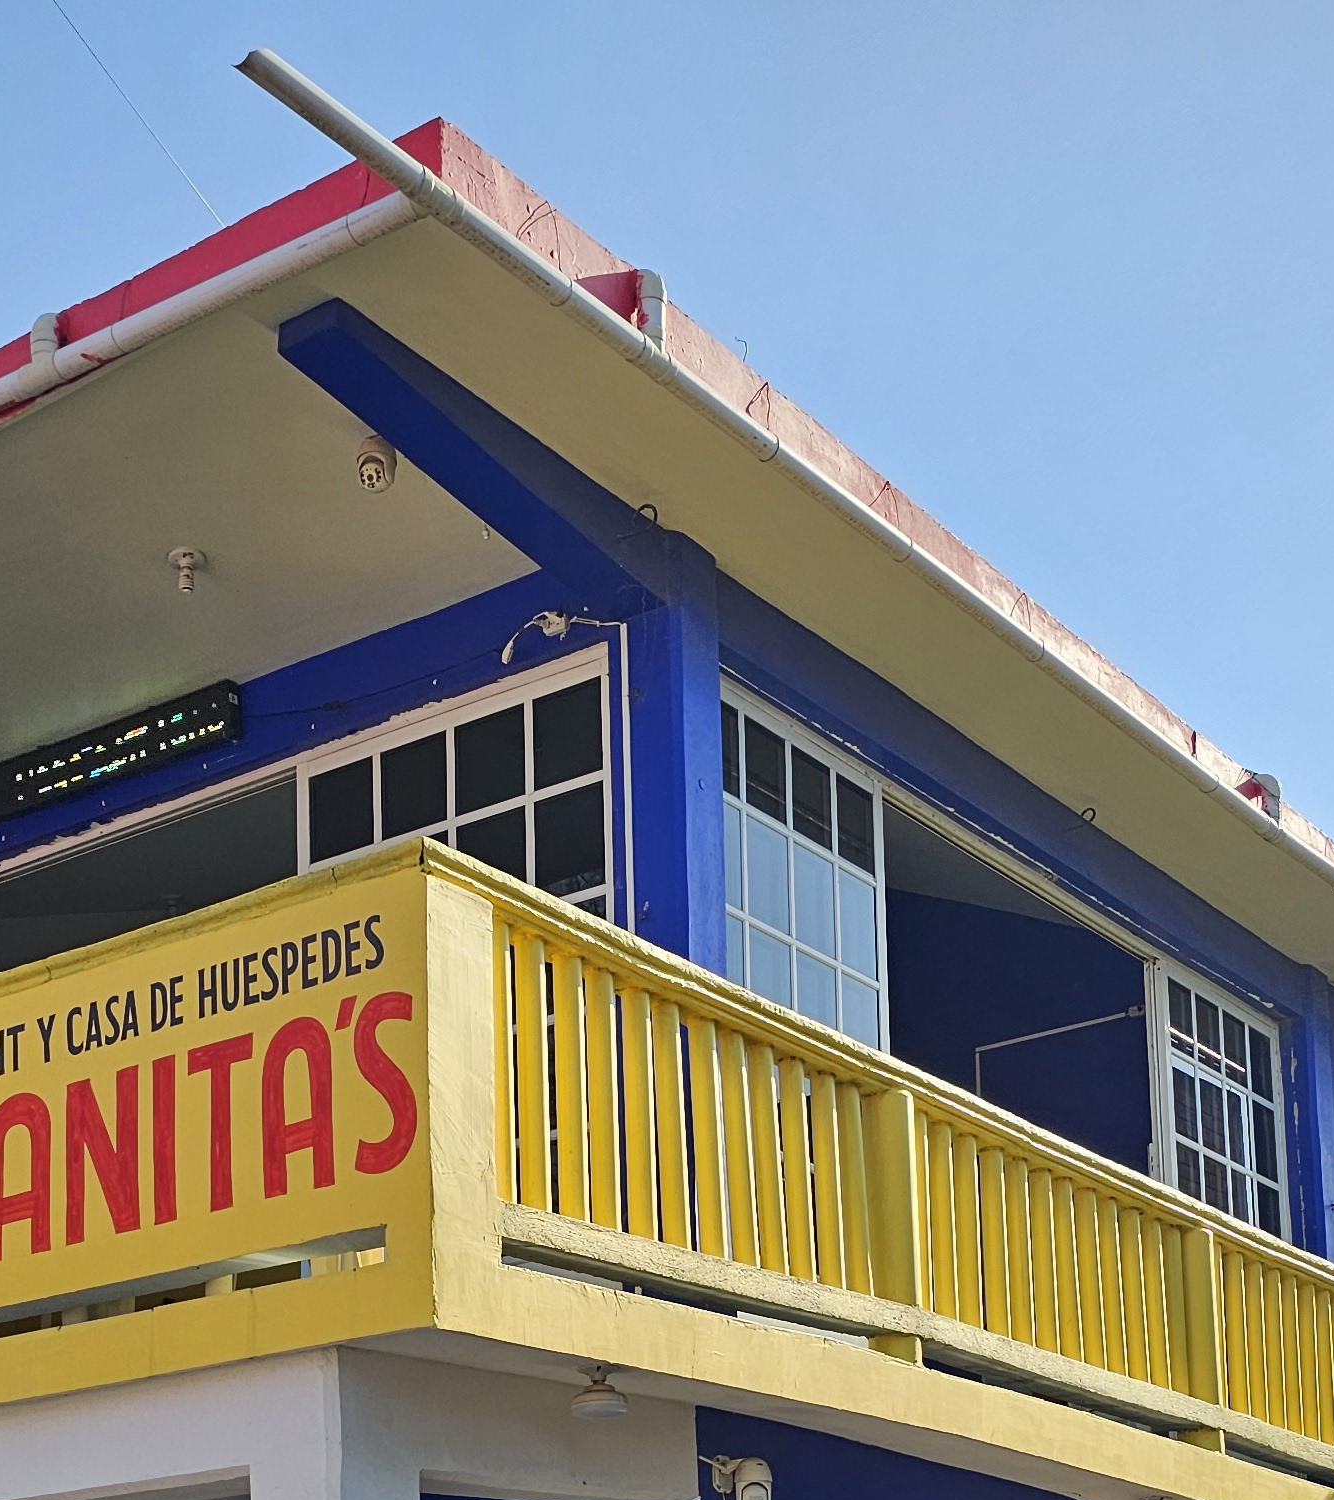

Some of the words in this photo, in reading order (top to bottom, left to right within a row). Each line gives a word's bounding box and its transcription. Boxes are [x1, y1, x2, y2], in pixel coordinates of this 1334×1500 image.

[36, 1013, 56, 1063] Y
[66, 990, 140, 1056] CASA
[150, 975, 184, 1032] DE
[198, 914, 385, 1019] HUESPEDES
